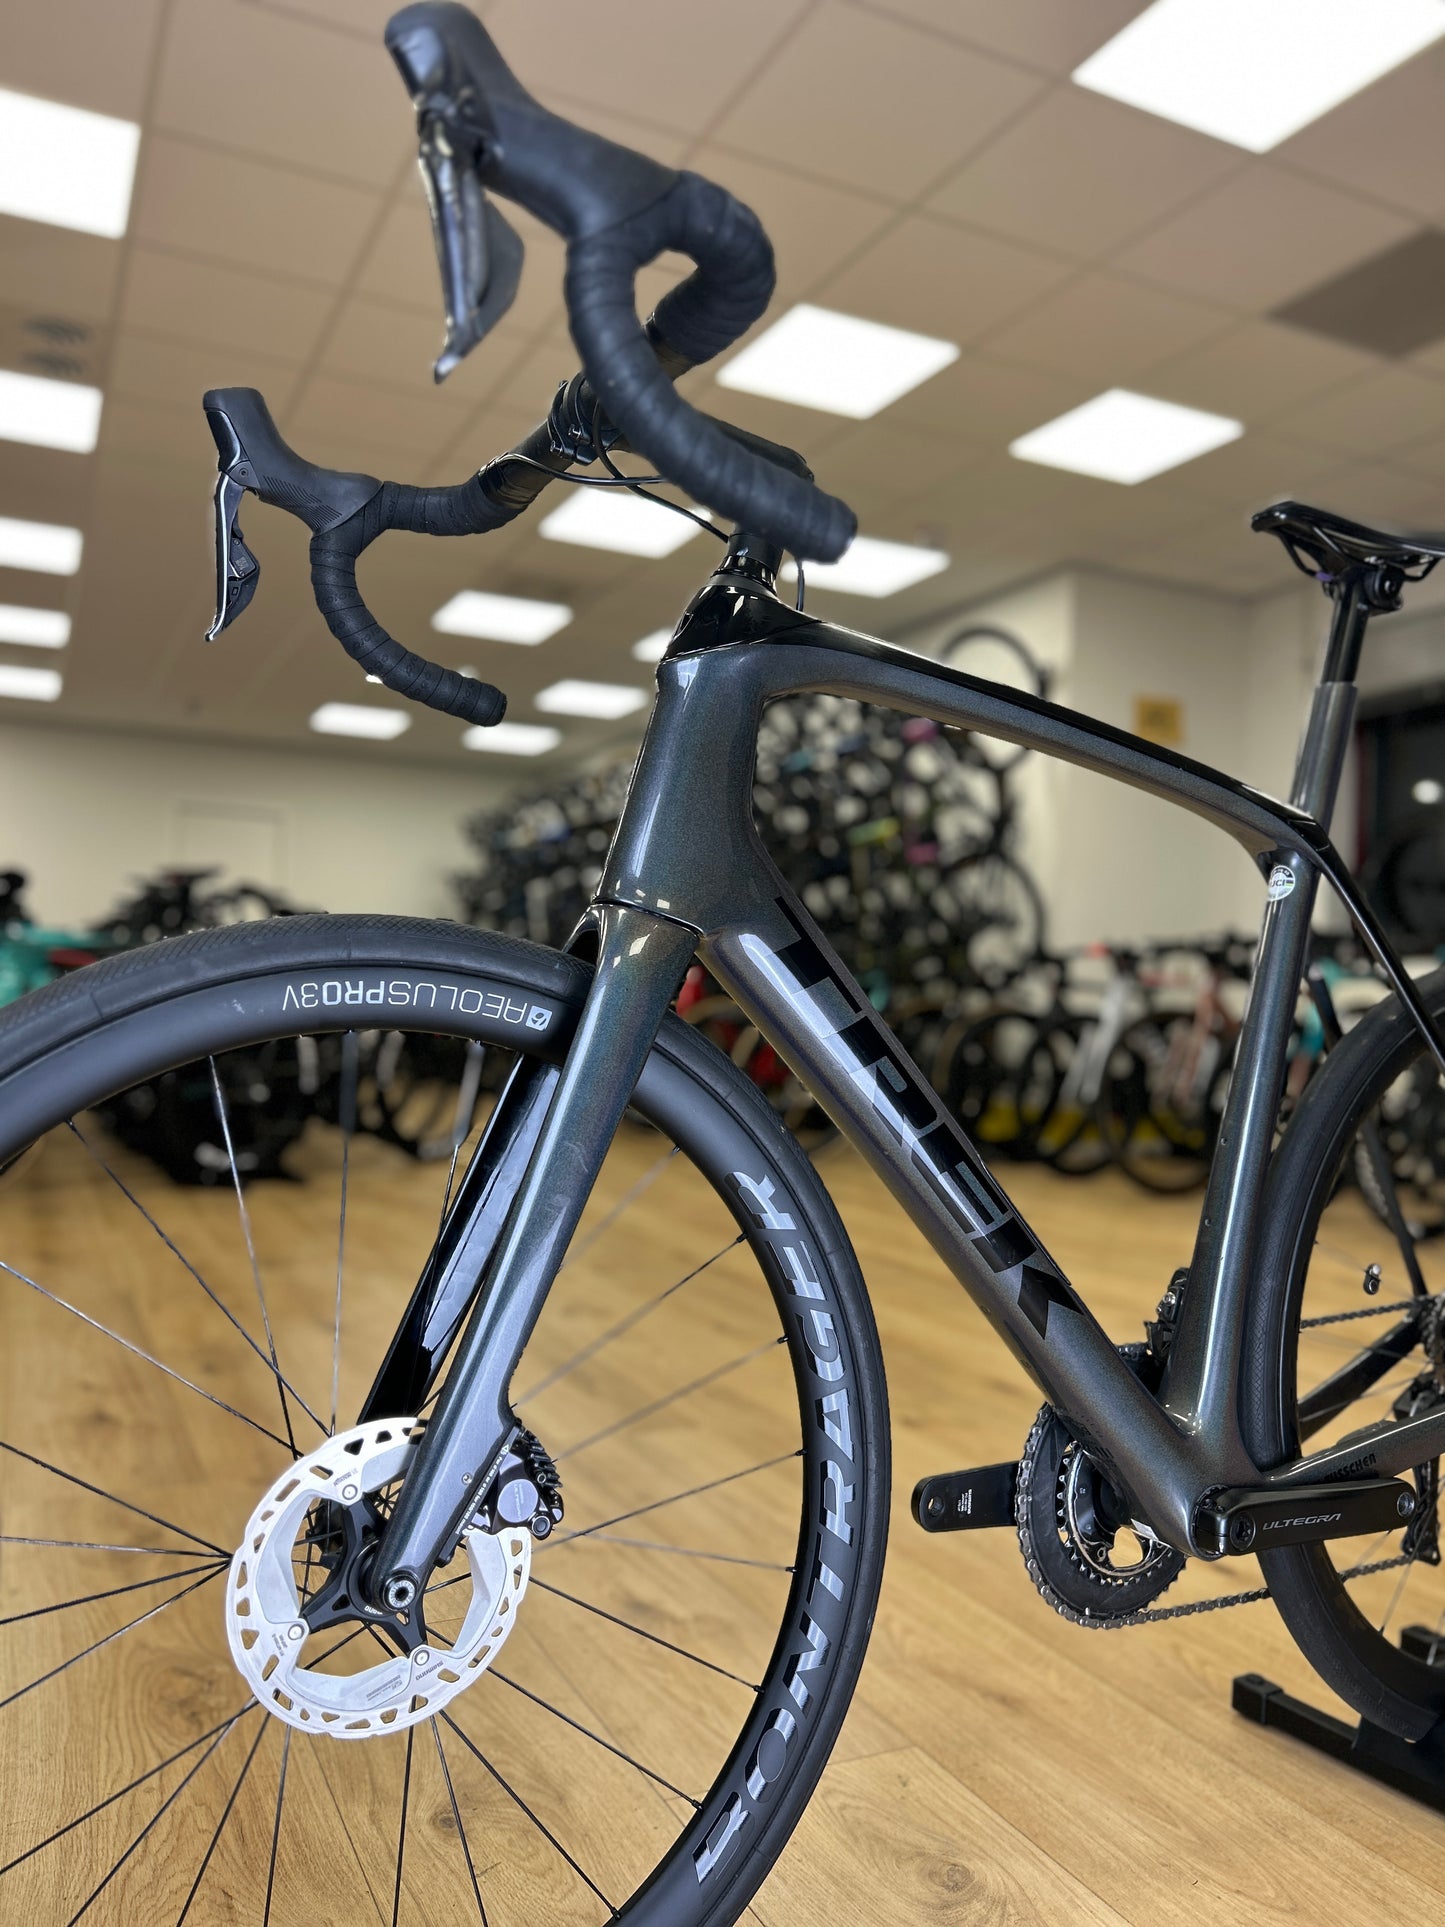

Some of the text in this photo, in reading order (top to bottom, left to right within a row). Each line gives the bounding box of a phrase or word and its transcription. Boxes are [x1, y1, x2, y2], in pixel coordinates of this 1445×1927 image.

[763, 896, 1086, 1340] TREK
[692, 1171, 856, 1884] BONTRAGER
[1262, 1513, 1342, 1531] ULTEGRA
